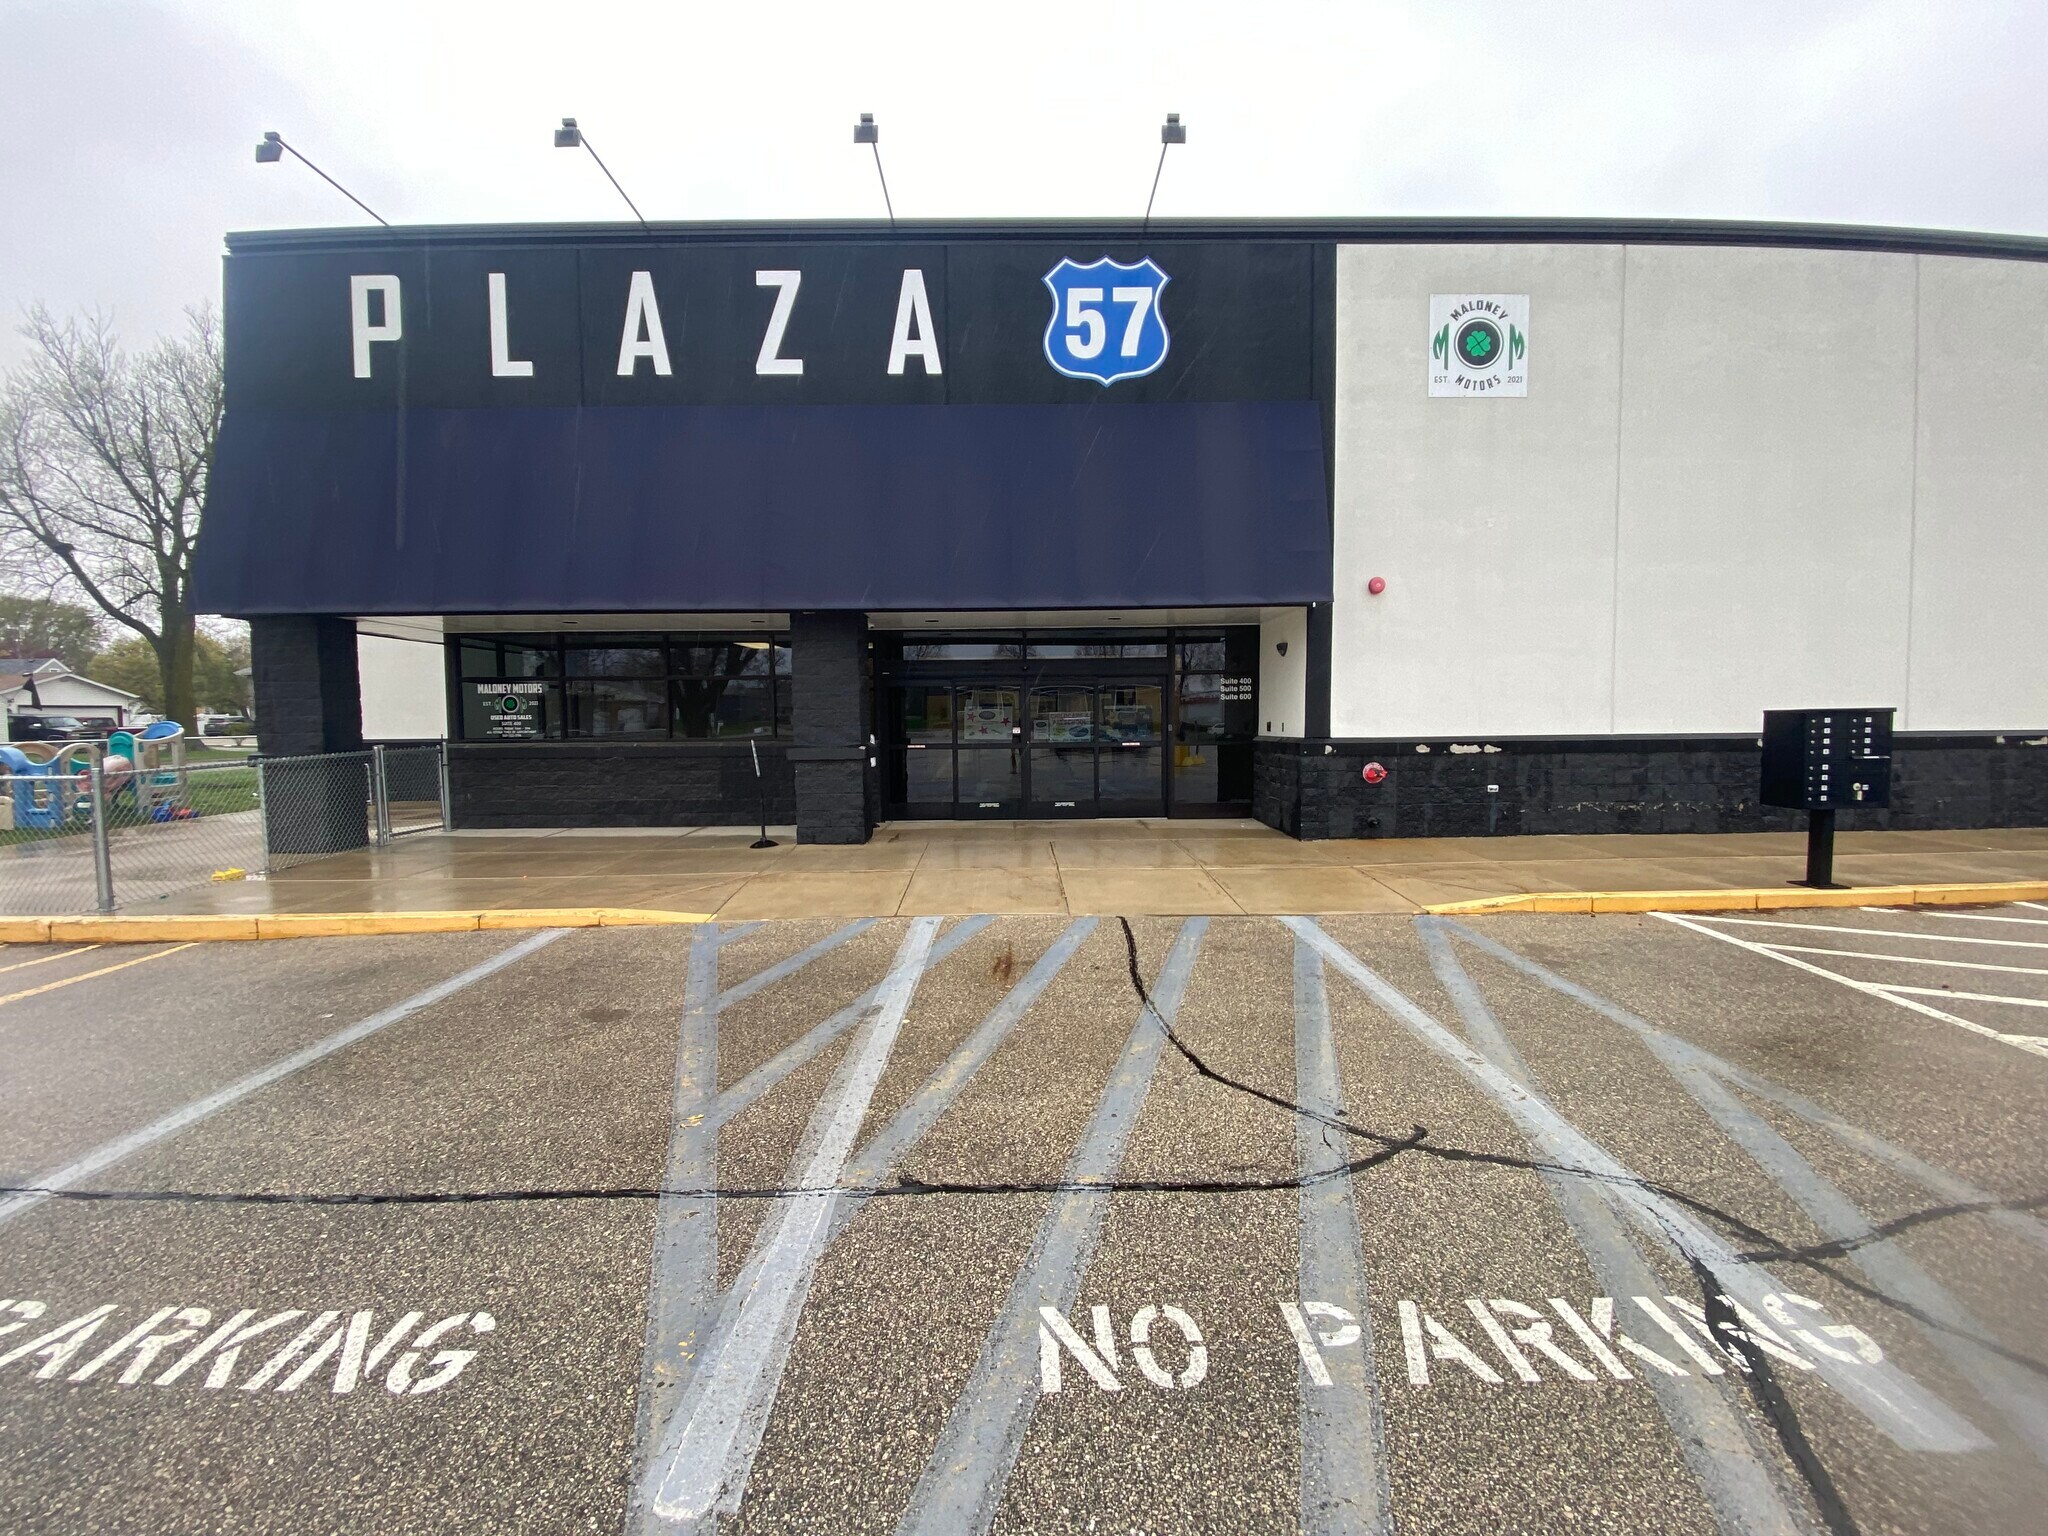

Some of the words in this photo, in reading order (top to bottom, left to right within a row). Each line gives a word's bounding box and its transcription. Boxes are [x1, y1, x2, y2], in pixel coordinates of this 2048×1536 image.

[1450, 300, 1508, 321] MALONEY
[350, 269, 943, 378] PLAZA
[1065, 286, 1153, 359] 57
[1455, 374, 1501, 391] MOTORS
[1507, 375, 1523, 383] 2021
[477, 684, 511, 694] MALONEY
[512, 684, 542, 694] MOTORS
[1038, 1303, 1209, 1394] NO
[1278, 1293, 1884, 1386] PARKING
